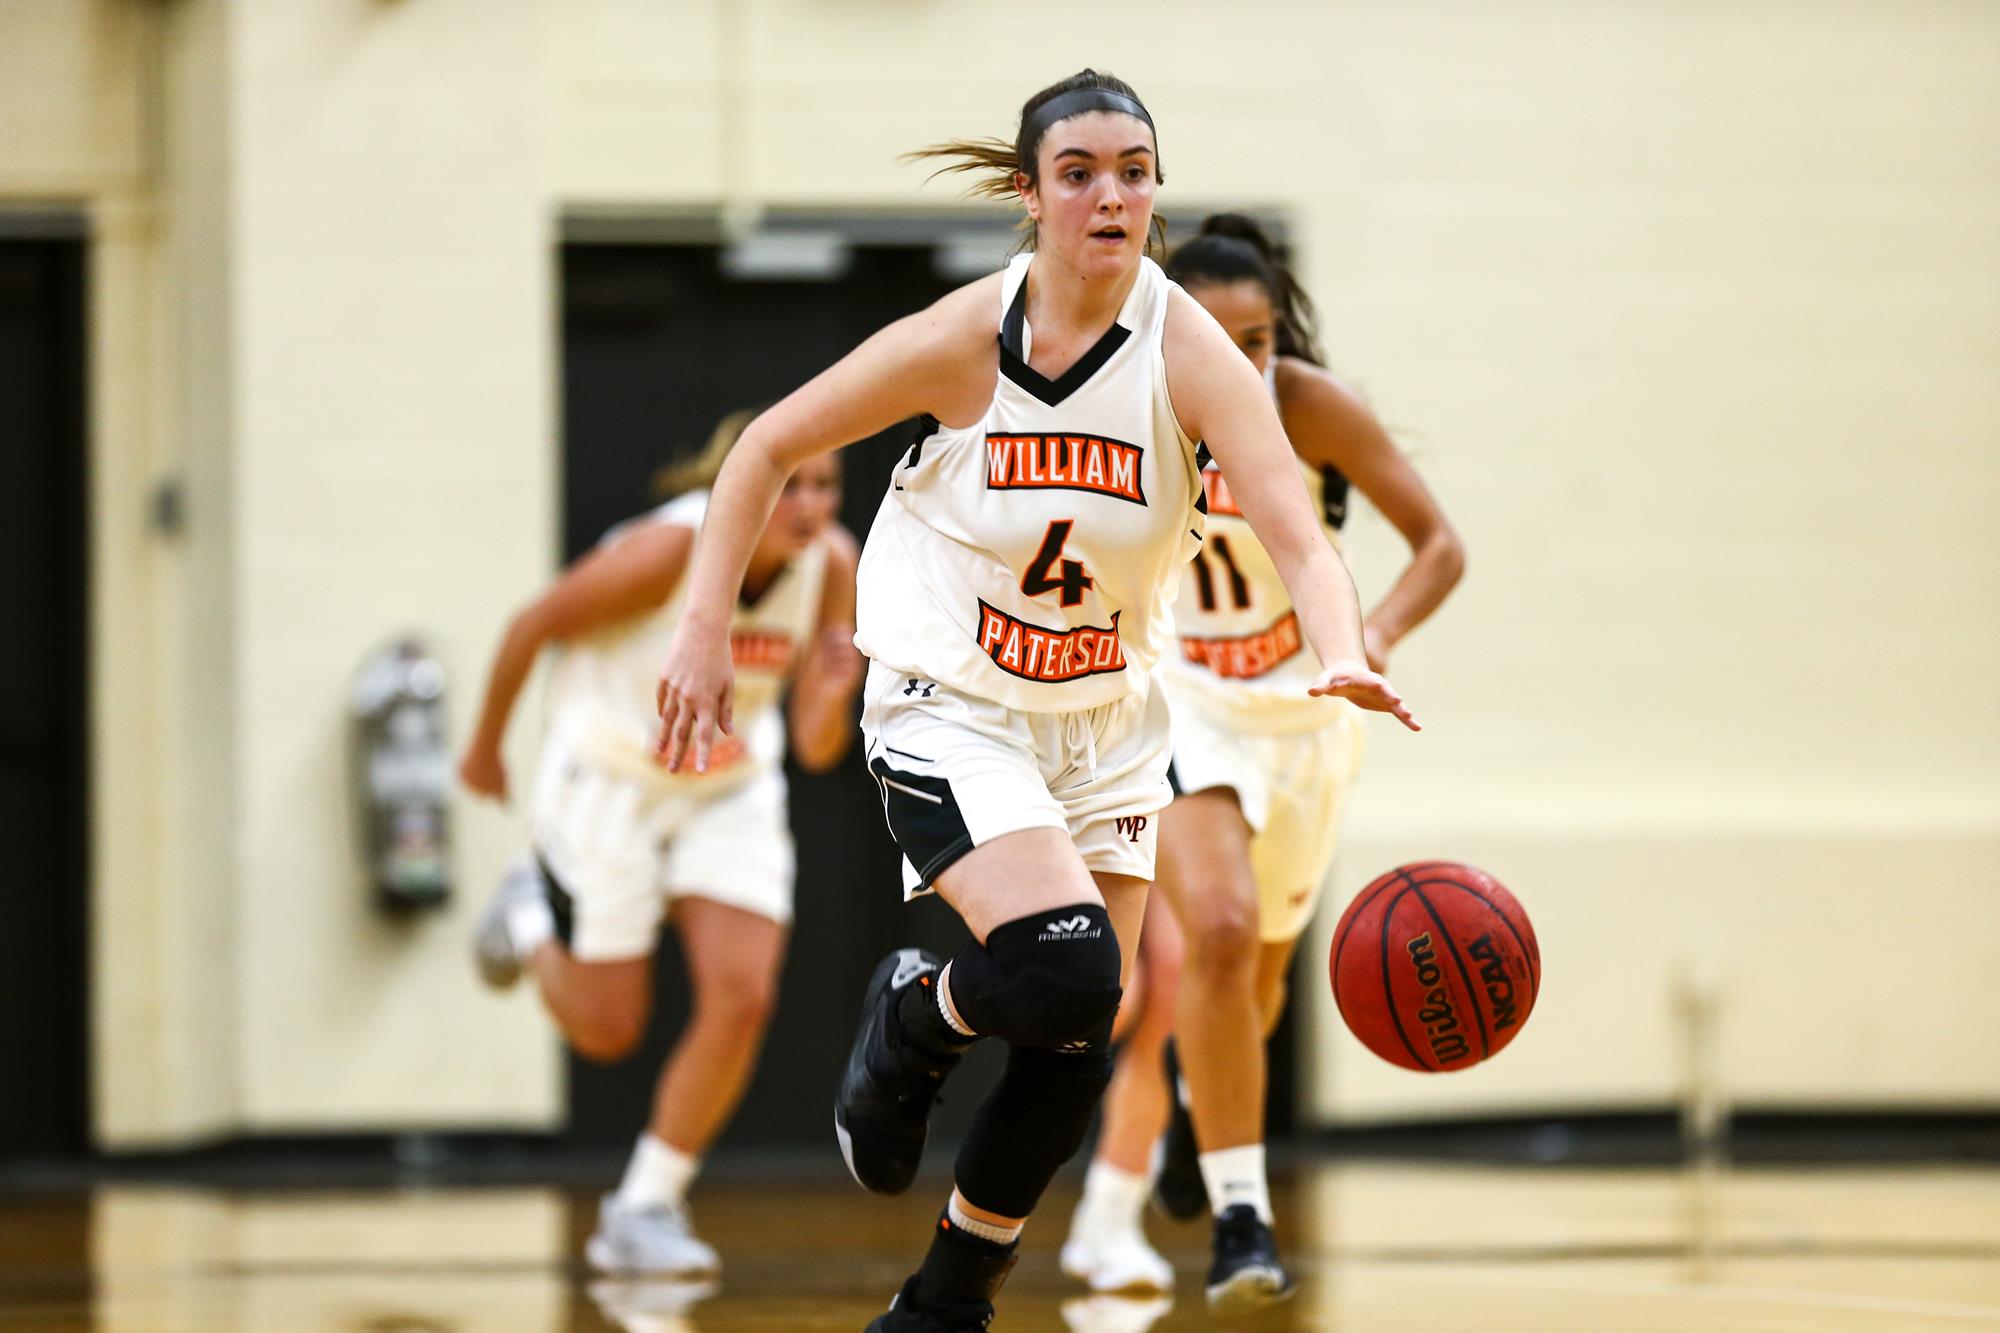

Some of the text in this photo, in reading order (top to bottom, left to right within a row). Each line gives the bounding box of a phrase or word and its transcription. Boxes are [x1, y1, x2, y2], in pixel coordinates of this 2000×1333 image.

[986, 440, 1135, 494] WILLIAM
[1019, 518, 1094, 609] 4
[1190, 533, 1253, 613] 11
[1115, 816, 1147, 842] WP
[1407, 932, 1470, 1064] Wilson
[1467, 934, 1517, 1032] NCAA
